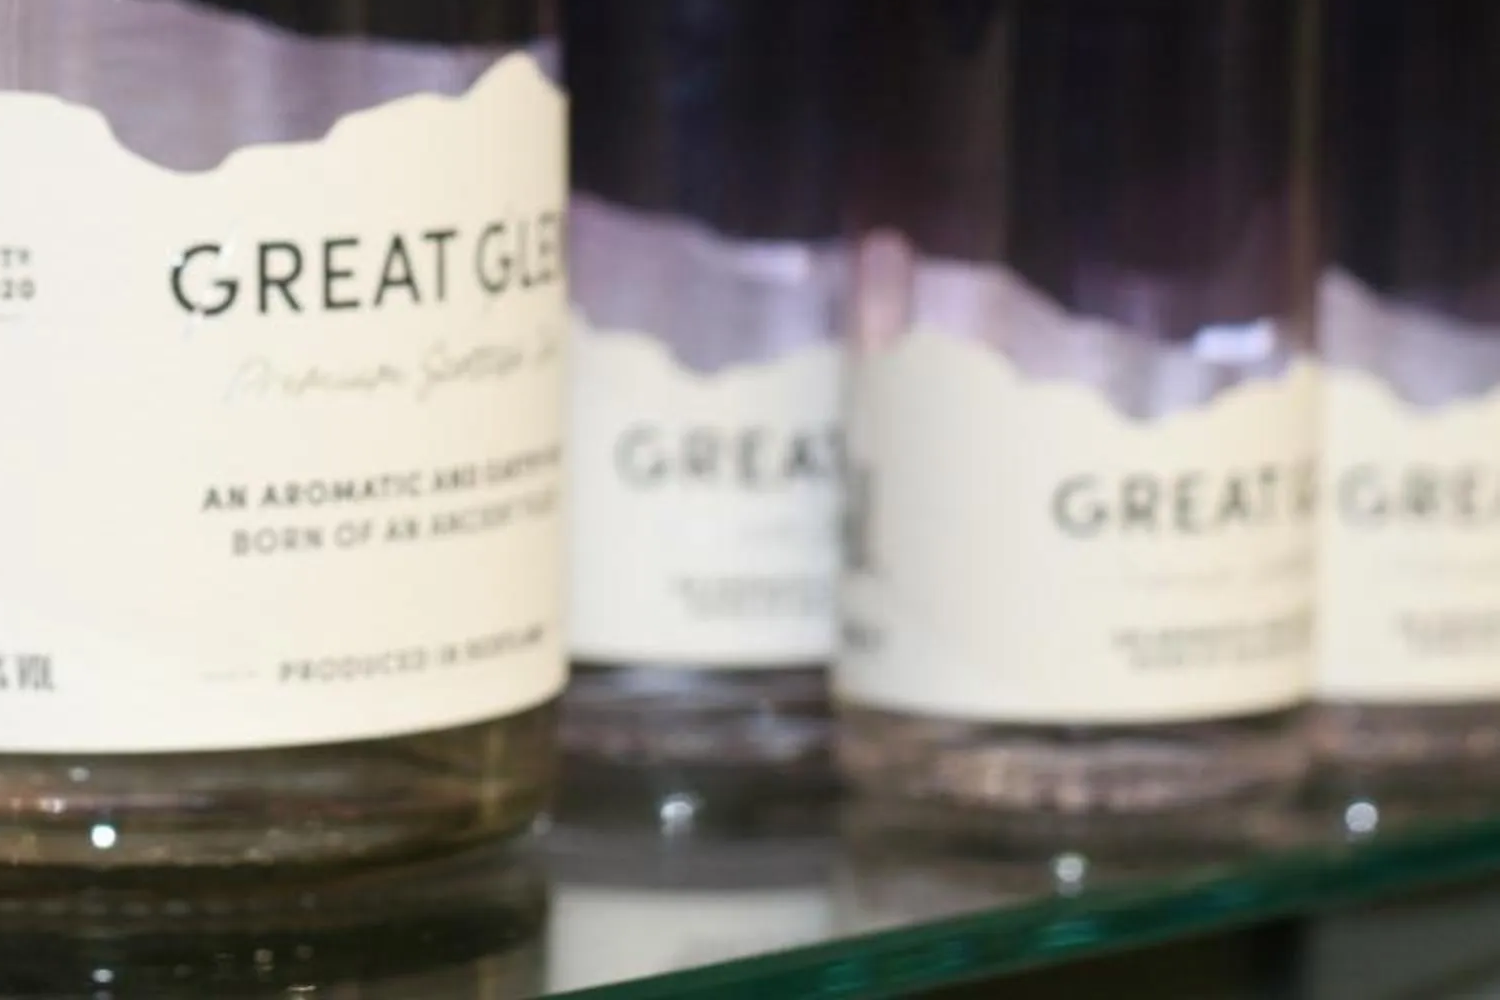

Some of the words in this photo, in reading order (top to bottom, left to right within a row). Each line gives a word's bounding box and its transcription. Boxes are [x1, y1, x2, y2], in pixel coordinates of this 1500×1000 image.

[170, 227, 460, 318] GREAT
[476, 211, 566, 296] GLE
[201, 485, 249, 513] AN
[257, 470, 422, 509] AROMATIC
